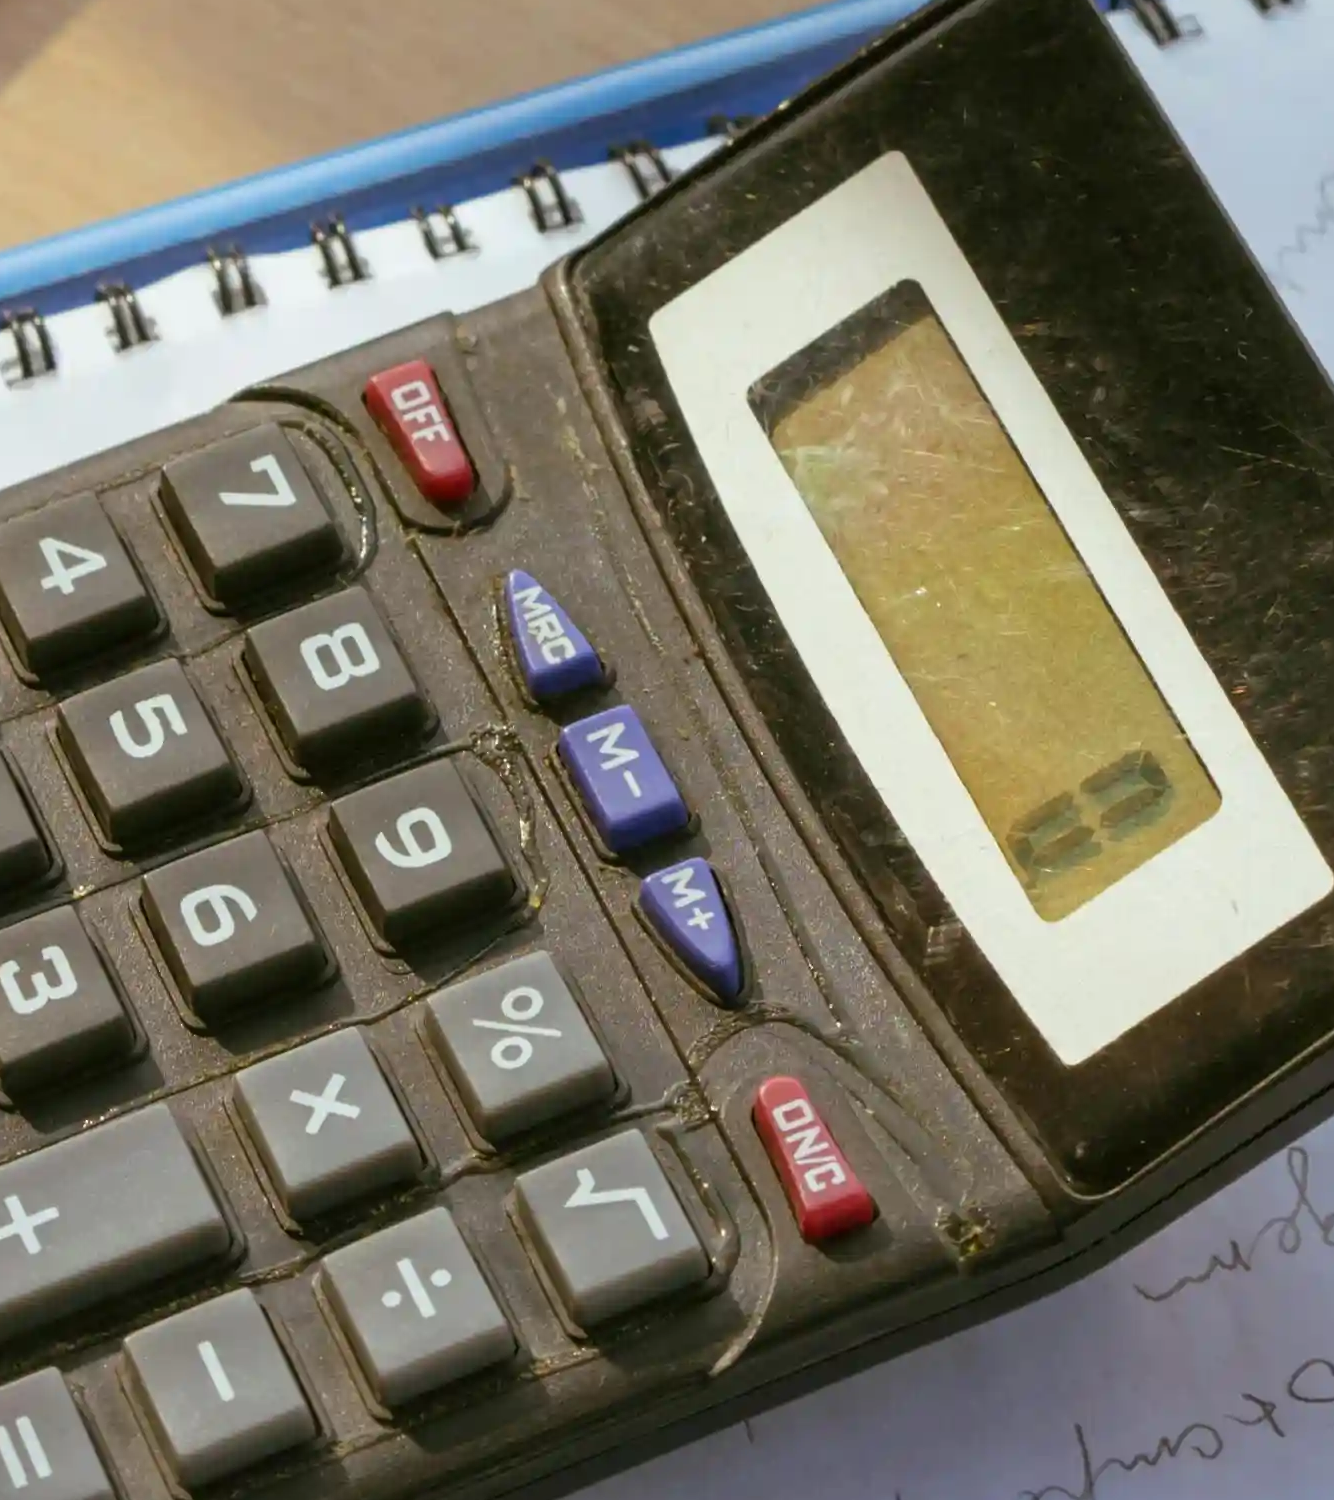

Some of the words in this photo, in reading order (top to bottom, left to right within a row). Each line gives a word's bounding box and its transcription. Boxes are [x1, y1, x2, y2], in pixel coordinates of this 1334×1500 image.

[390, 380, 451, 447] OFF
[217, 455, 296, 510] 7
[39, 536, 108, 596] 4
[300, 623, 381, 690] 8
[514, 584, 574, 666] MRC
[109, 693, 186, 761] 5
[587, 723, 644, 798] M-
[375, 808, 452, 868] 9
[178, 884, 257, 946] 6
[661, 866, 716, 931] M+
[472, 986, 562, 1071] %
[773, 1097, 845, 1192] ON/C
